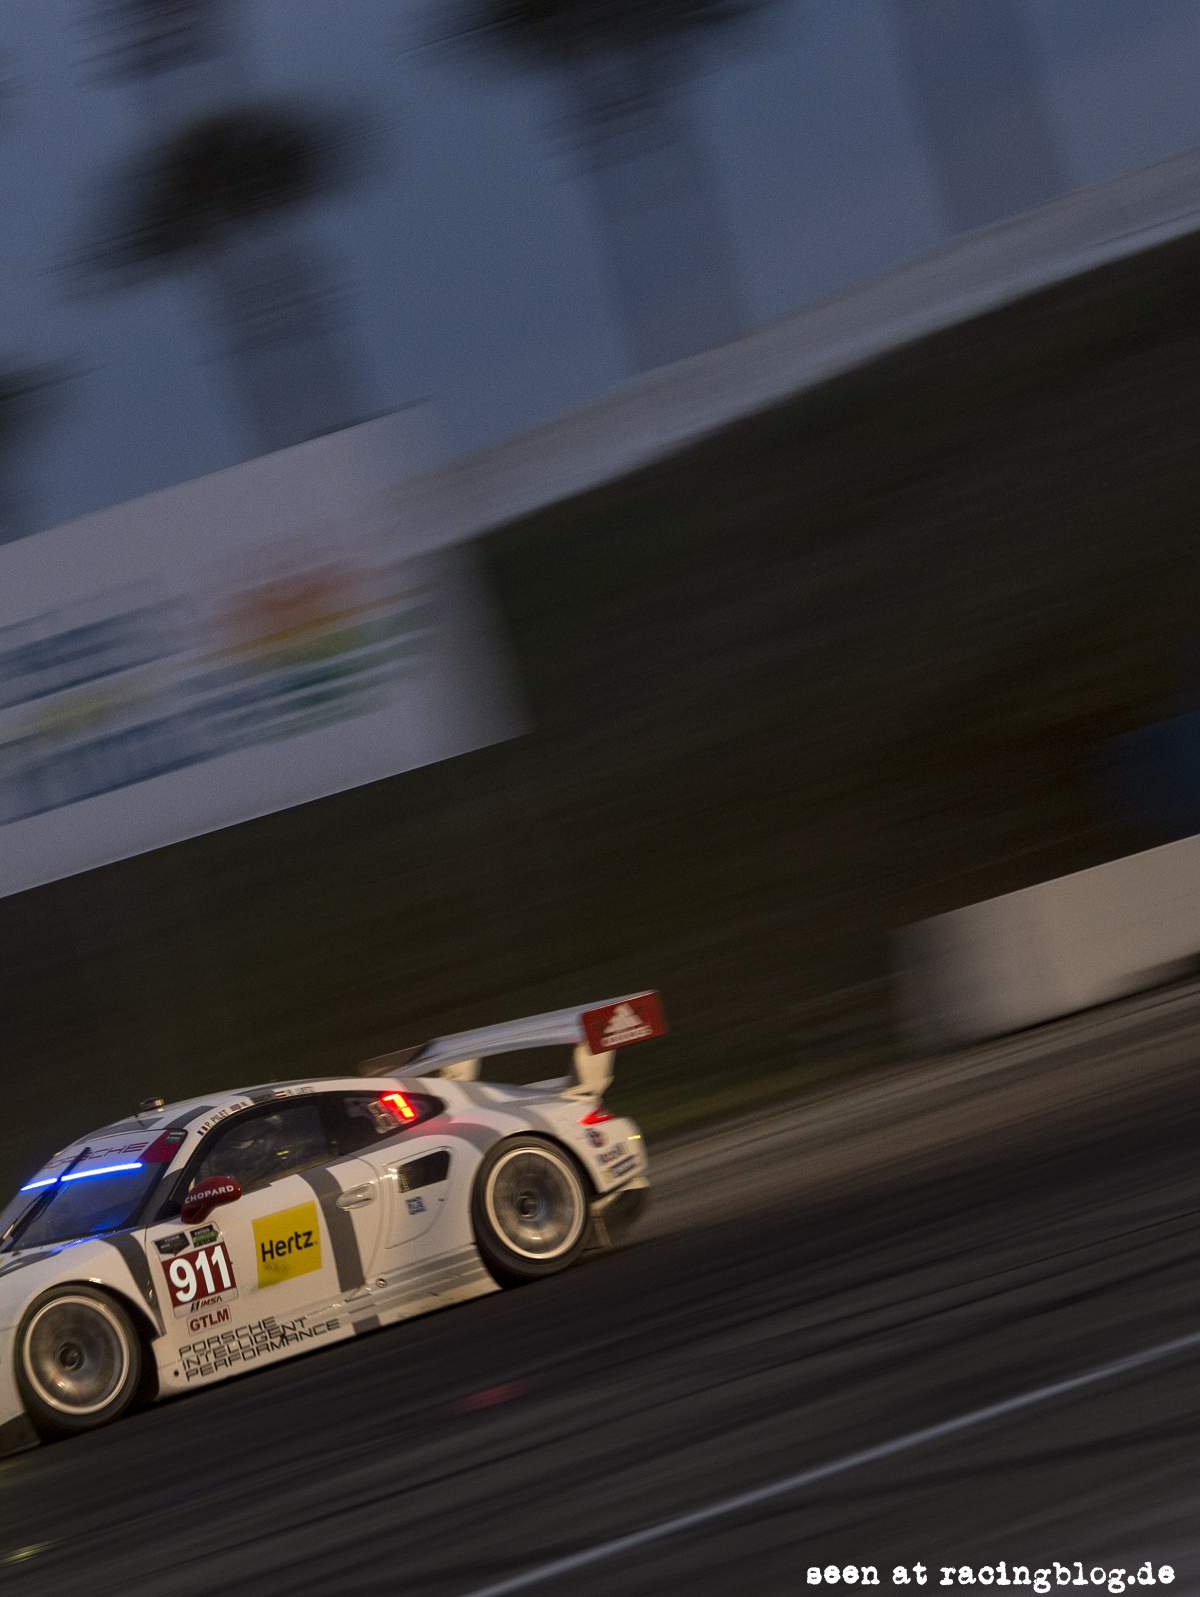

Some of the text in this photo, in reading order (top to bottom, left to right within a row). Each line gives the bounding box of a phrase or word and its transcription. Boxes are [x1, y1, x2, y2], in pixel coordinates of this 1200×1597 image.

[184, 1184, 235, 1204] CHOPARD
[261, 1230, 314, 1263] Hertz
[169, 1245, 232, 1303] 911
[179, 1316, 277, 1359] PORSCHE
[189, 1308, 230, 1332] GTLM
[182, 1316, 308, 1370] INTELLIGENT
[186, 1318, 341, 1382] PERFORMANCE
